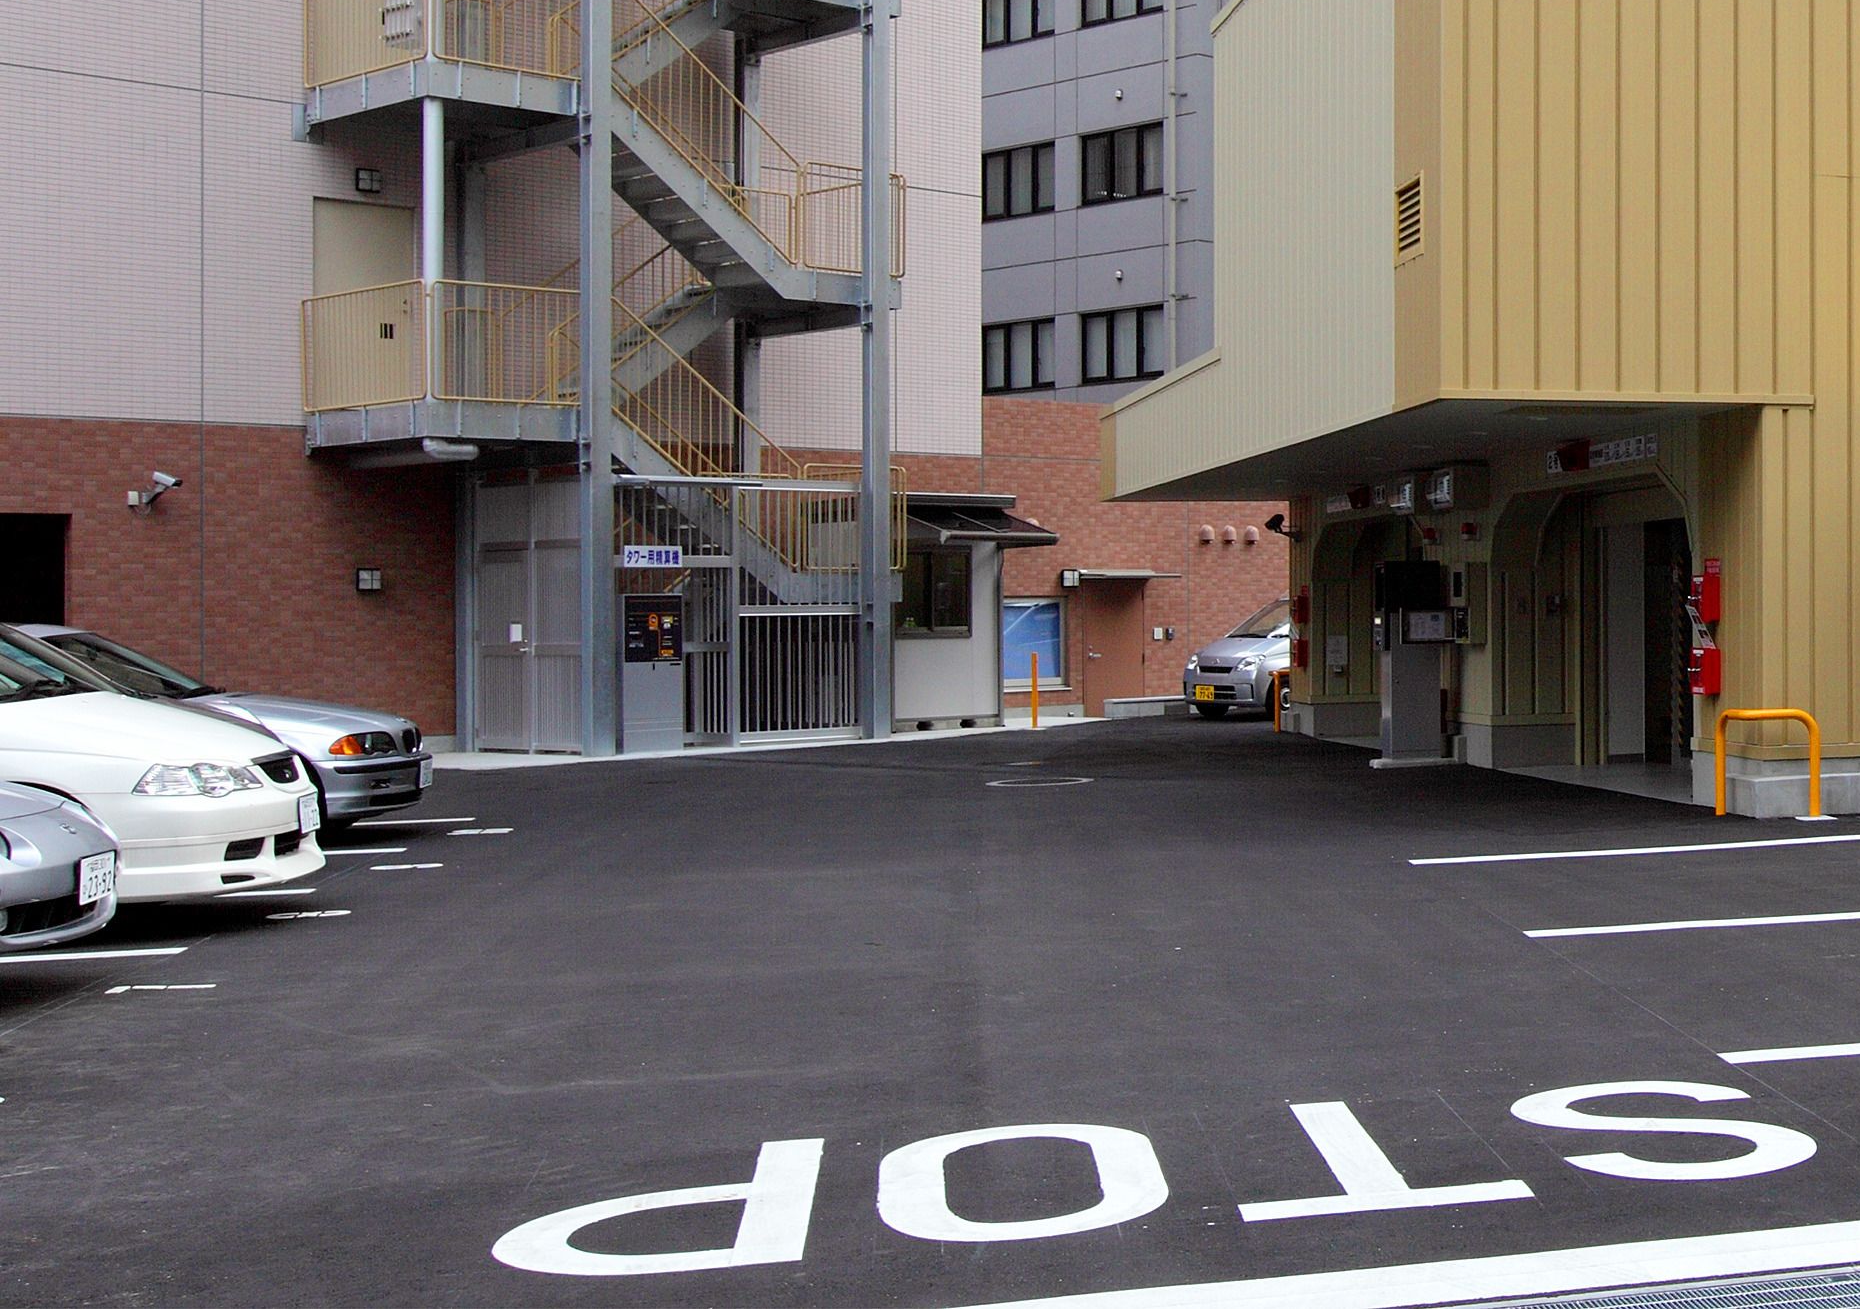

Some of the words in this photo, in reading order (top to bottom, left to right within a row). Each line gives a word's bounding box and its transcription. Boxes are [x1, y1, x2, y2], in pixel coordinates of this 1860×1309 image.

[626, 549, 680, 565] タワー用精算機
[491, 1080, 1818, 1276] STOP
